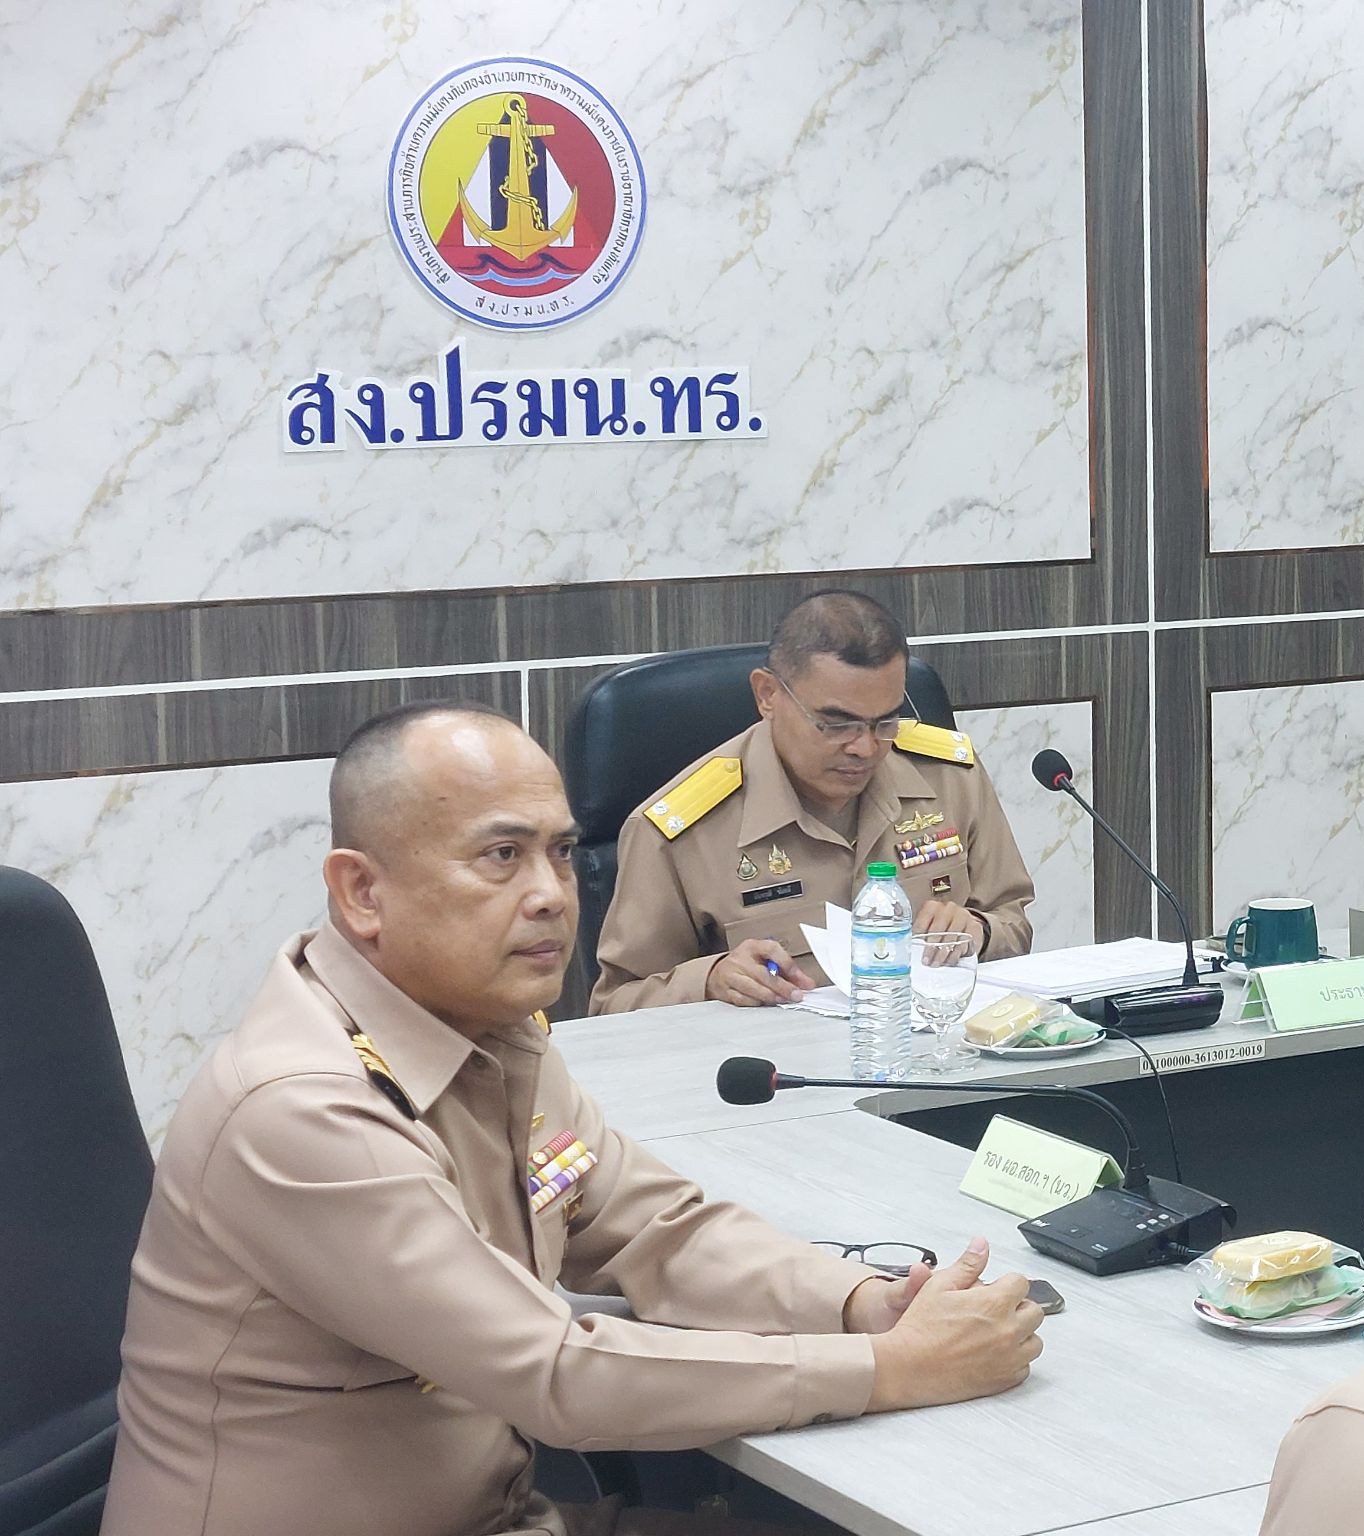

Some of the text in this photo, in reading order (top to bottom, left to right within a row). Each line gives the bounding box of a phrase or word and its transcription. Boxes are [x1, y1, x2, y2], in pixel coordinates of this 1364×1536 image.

[287, 345, 762, 446] สง.ปรมน.ทร.
[983, 1151, 1003, 1170] รอง
